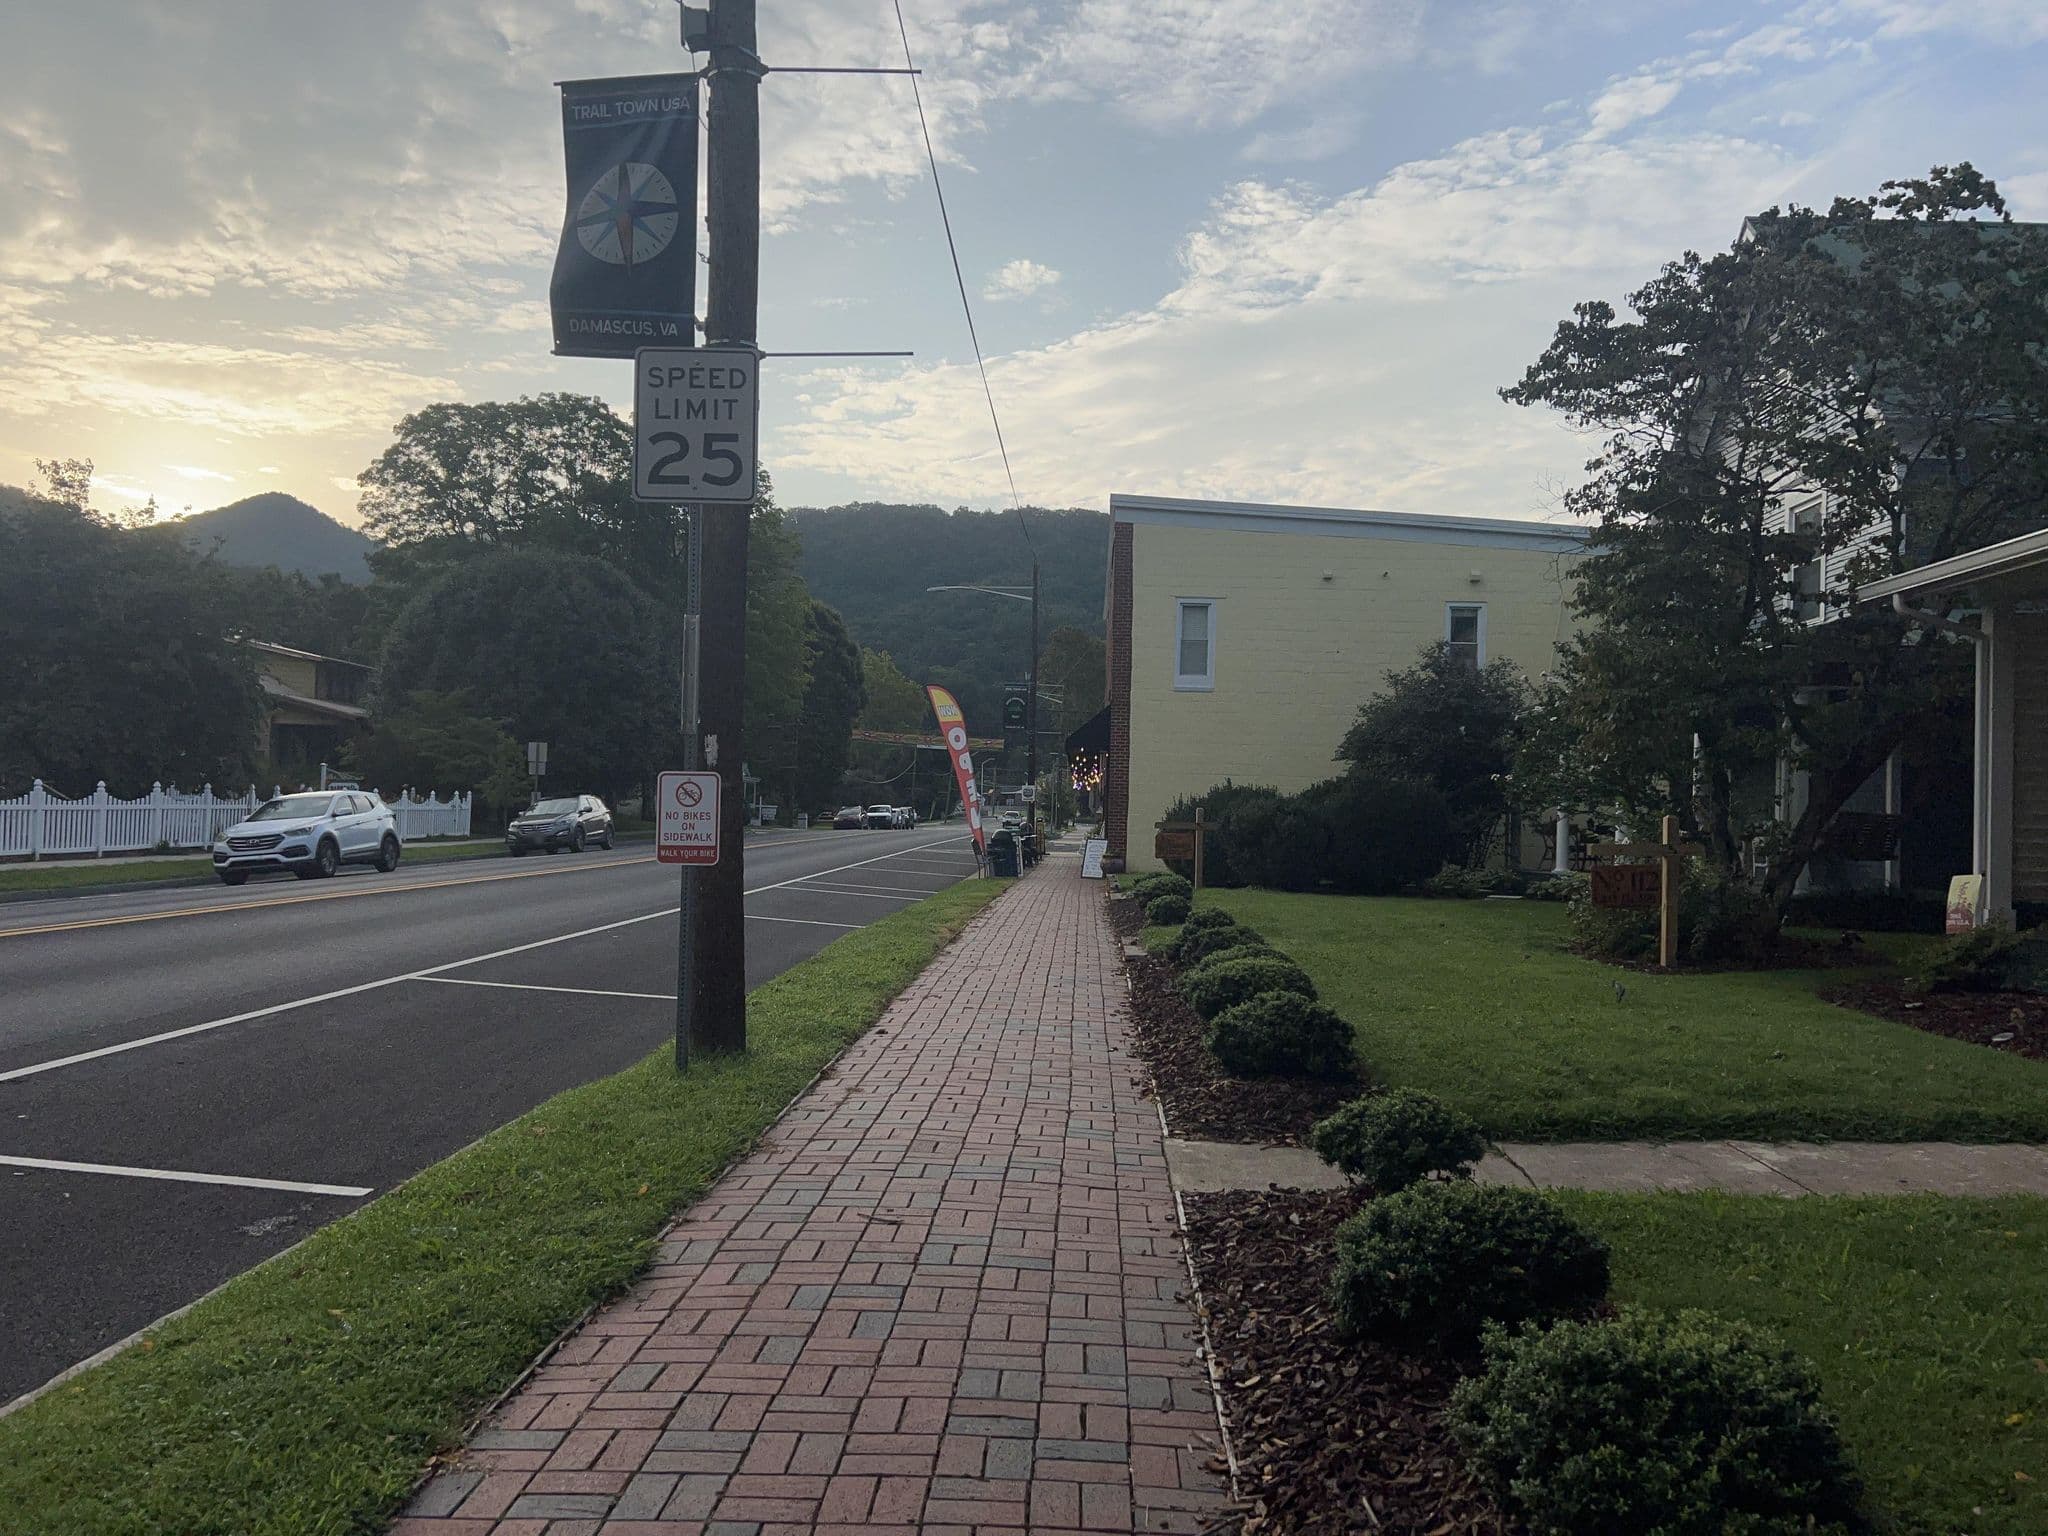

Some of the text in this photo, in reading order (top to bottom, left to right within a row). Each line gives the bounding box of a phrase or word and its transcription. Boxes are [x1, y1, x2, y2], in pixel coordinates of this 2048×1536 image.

[571, 96, 690, 121] TRAIL TOWN USA
[569, 319, 678, 337] DAMASCUS, VA
[648, 366, 747, 389] SPEED
[654, 398, 739, 420] LIMIT
[647, 431, 744, 486] 25
[665, 812, 711, 820] NO BIKES
[681, 822, 695, 831] ON
[663, 833, 712, 841] SIDEWALK
[660, 849, 678, 857] WALK
[680, 849, 698, 857] YOUR
